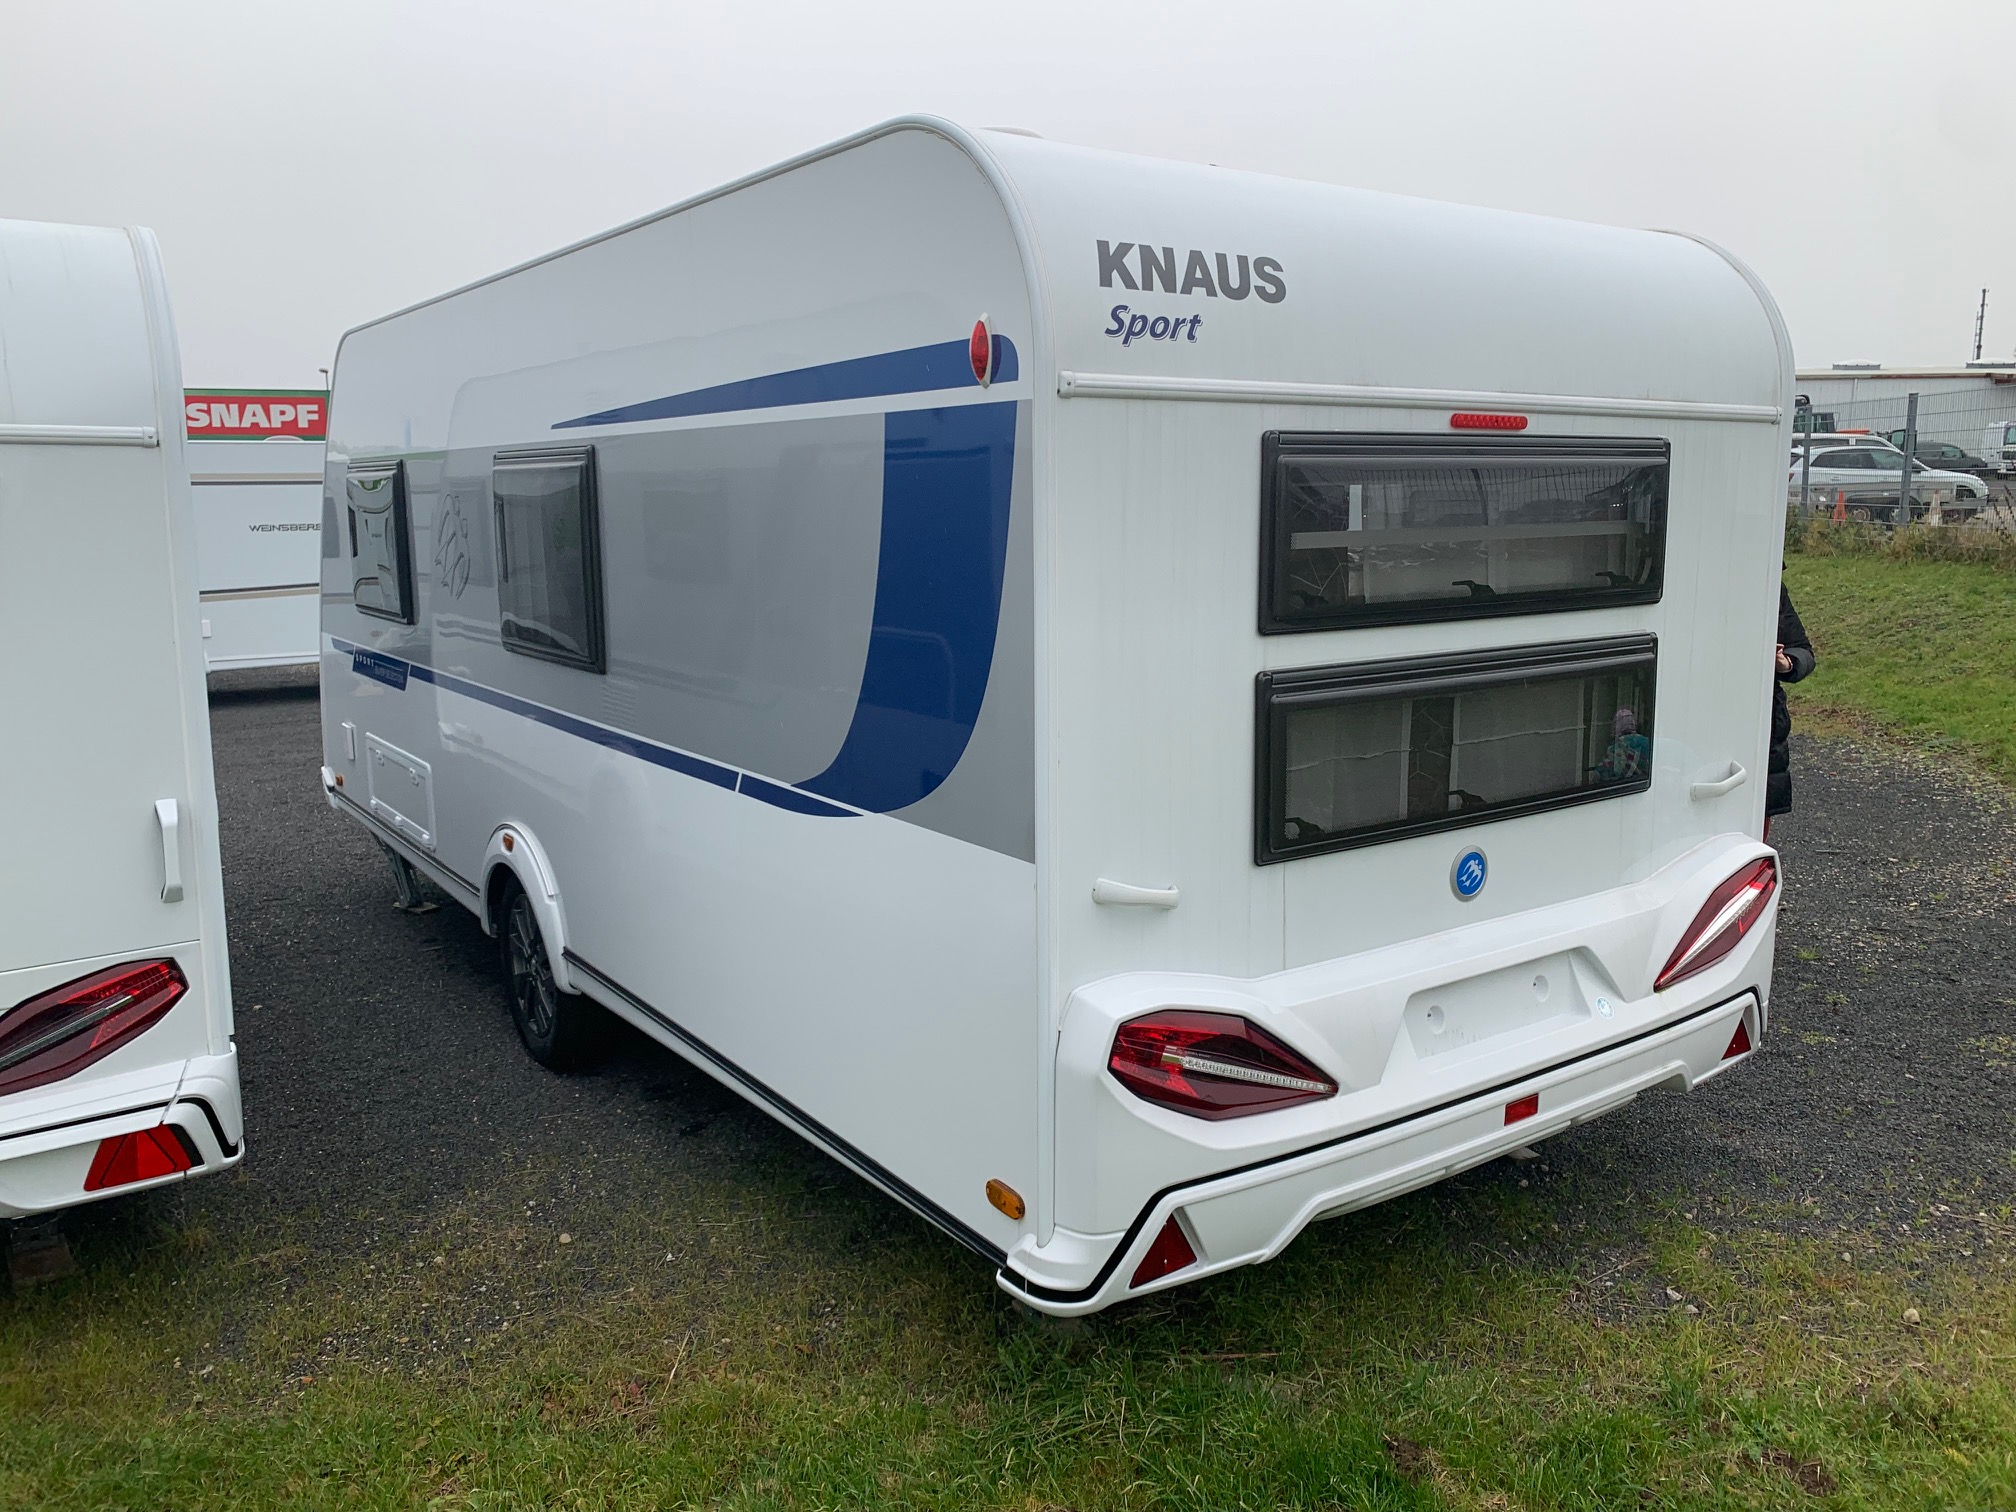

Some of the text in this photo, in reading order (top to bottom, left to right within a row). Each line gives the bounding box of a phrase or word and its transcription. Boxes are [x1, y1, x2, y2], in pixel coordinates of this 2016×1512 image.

[1096, 239, 1287, 304] KNAUS
[1104, 304, 1203, 348] Sport
[185, 402, 319, 429] SNAPF
